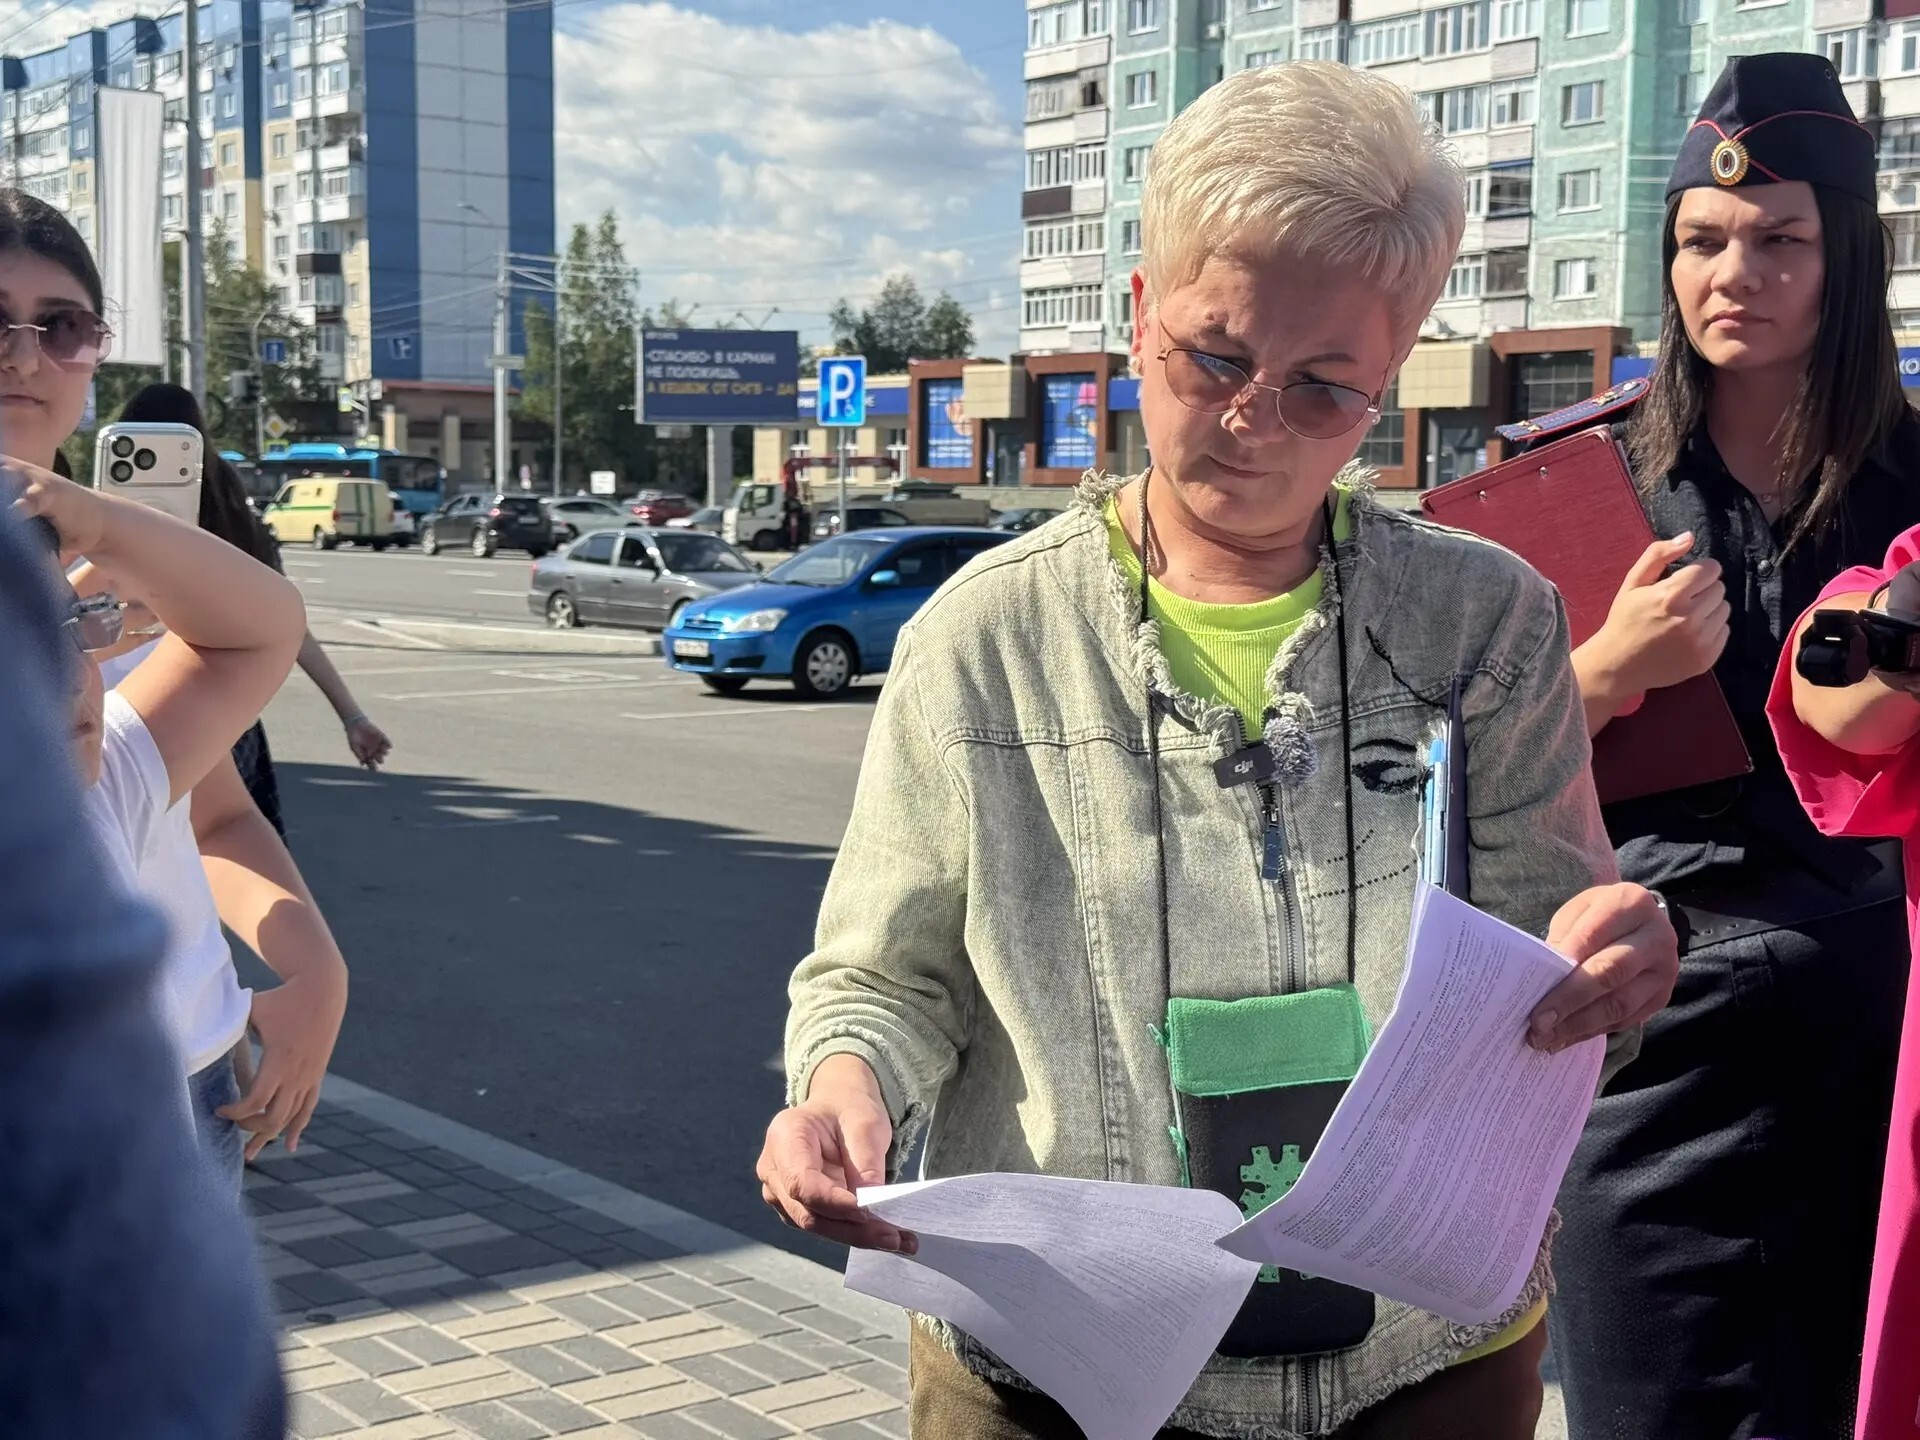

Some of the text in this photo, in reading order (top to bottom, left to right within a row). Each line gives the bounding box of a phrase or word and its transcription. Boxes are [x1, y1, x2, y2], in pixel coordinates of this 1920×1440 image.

[714, 351, 724, 363] В
[726, 352, 776, 364] КАРМАН
[646, 365, 663, 377] НЕ
